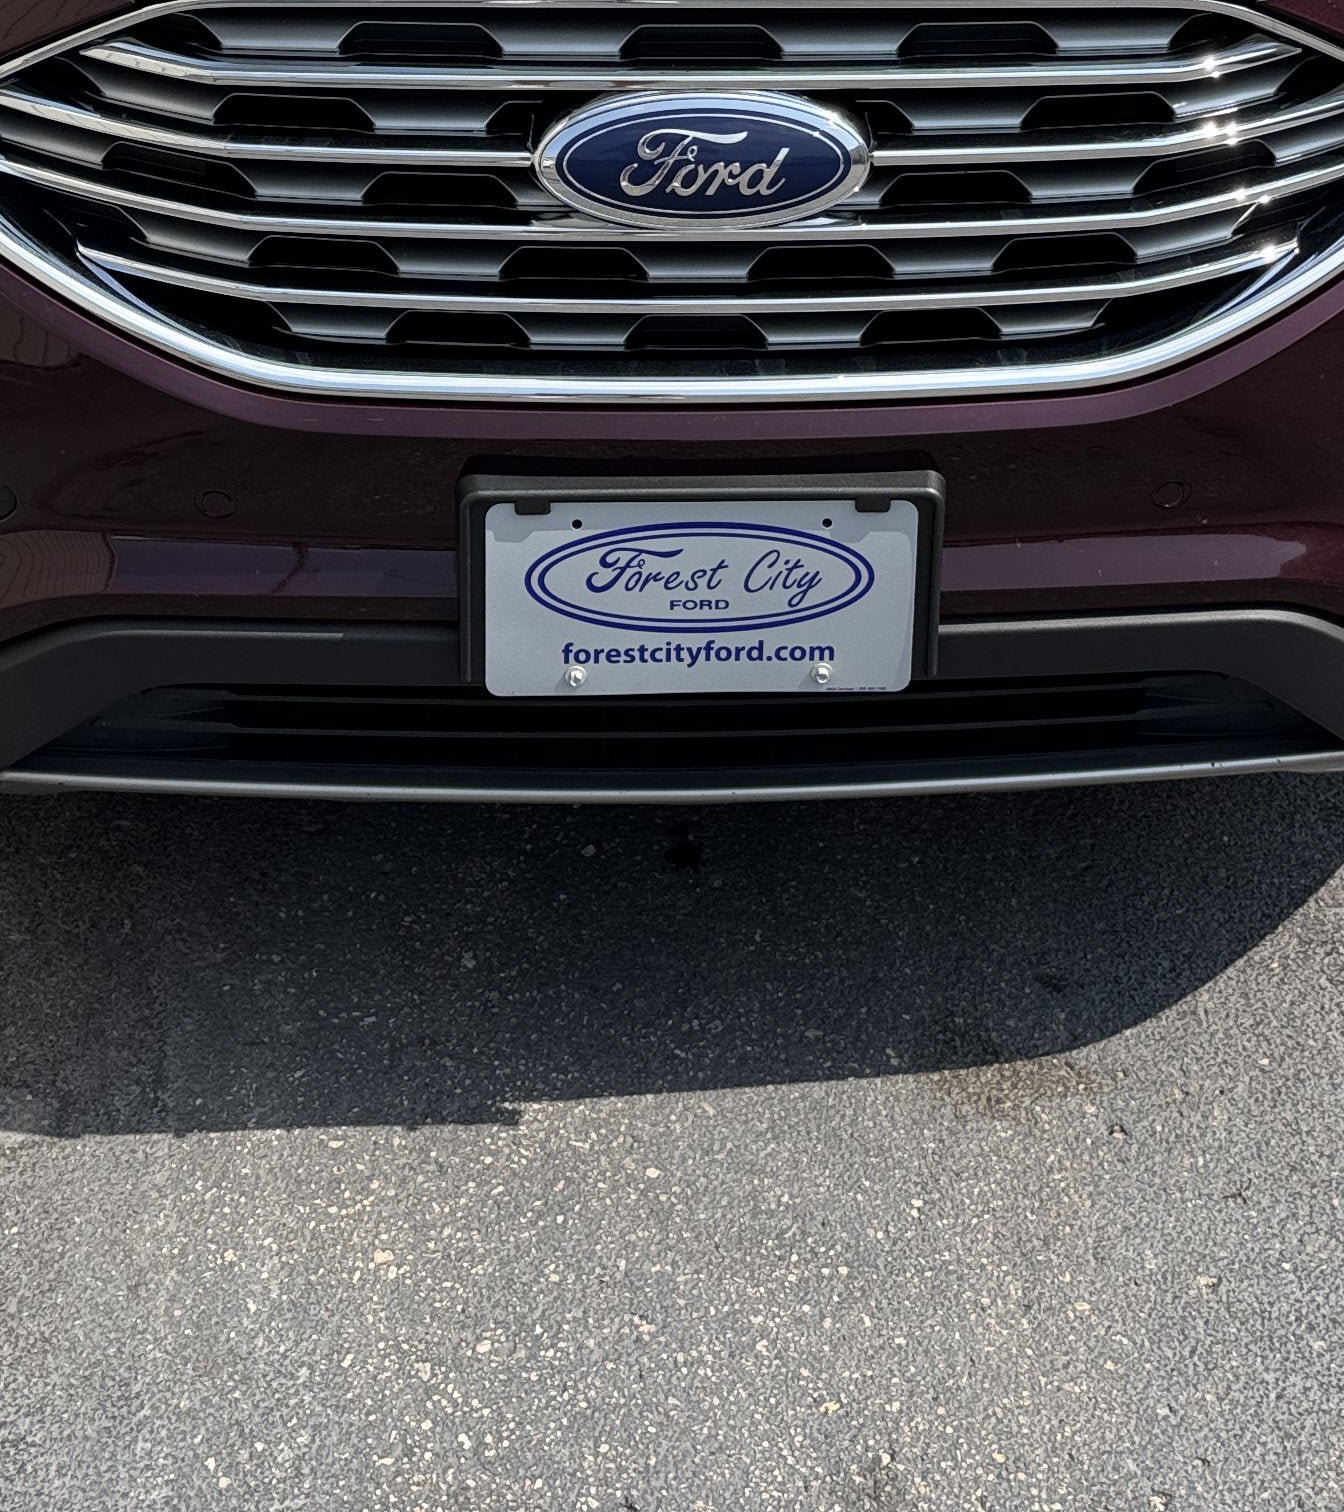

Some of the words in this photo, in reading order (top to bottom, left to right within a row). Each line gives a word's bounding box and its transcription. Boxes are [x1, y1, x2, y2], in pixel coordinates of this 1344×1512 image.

[619, 128, 791, 197] Ford
[585, 547, 729, 594] Forest
[743, 548, 823, 608] City
[669, 599, 730, 611] FORD
[562, 639, 835, 669] forestcityford.com
